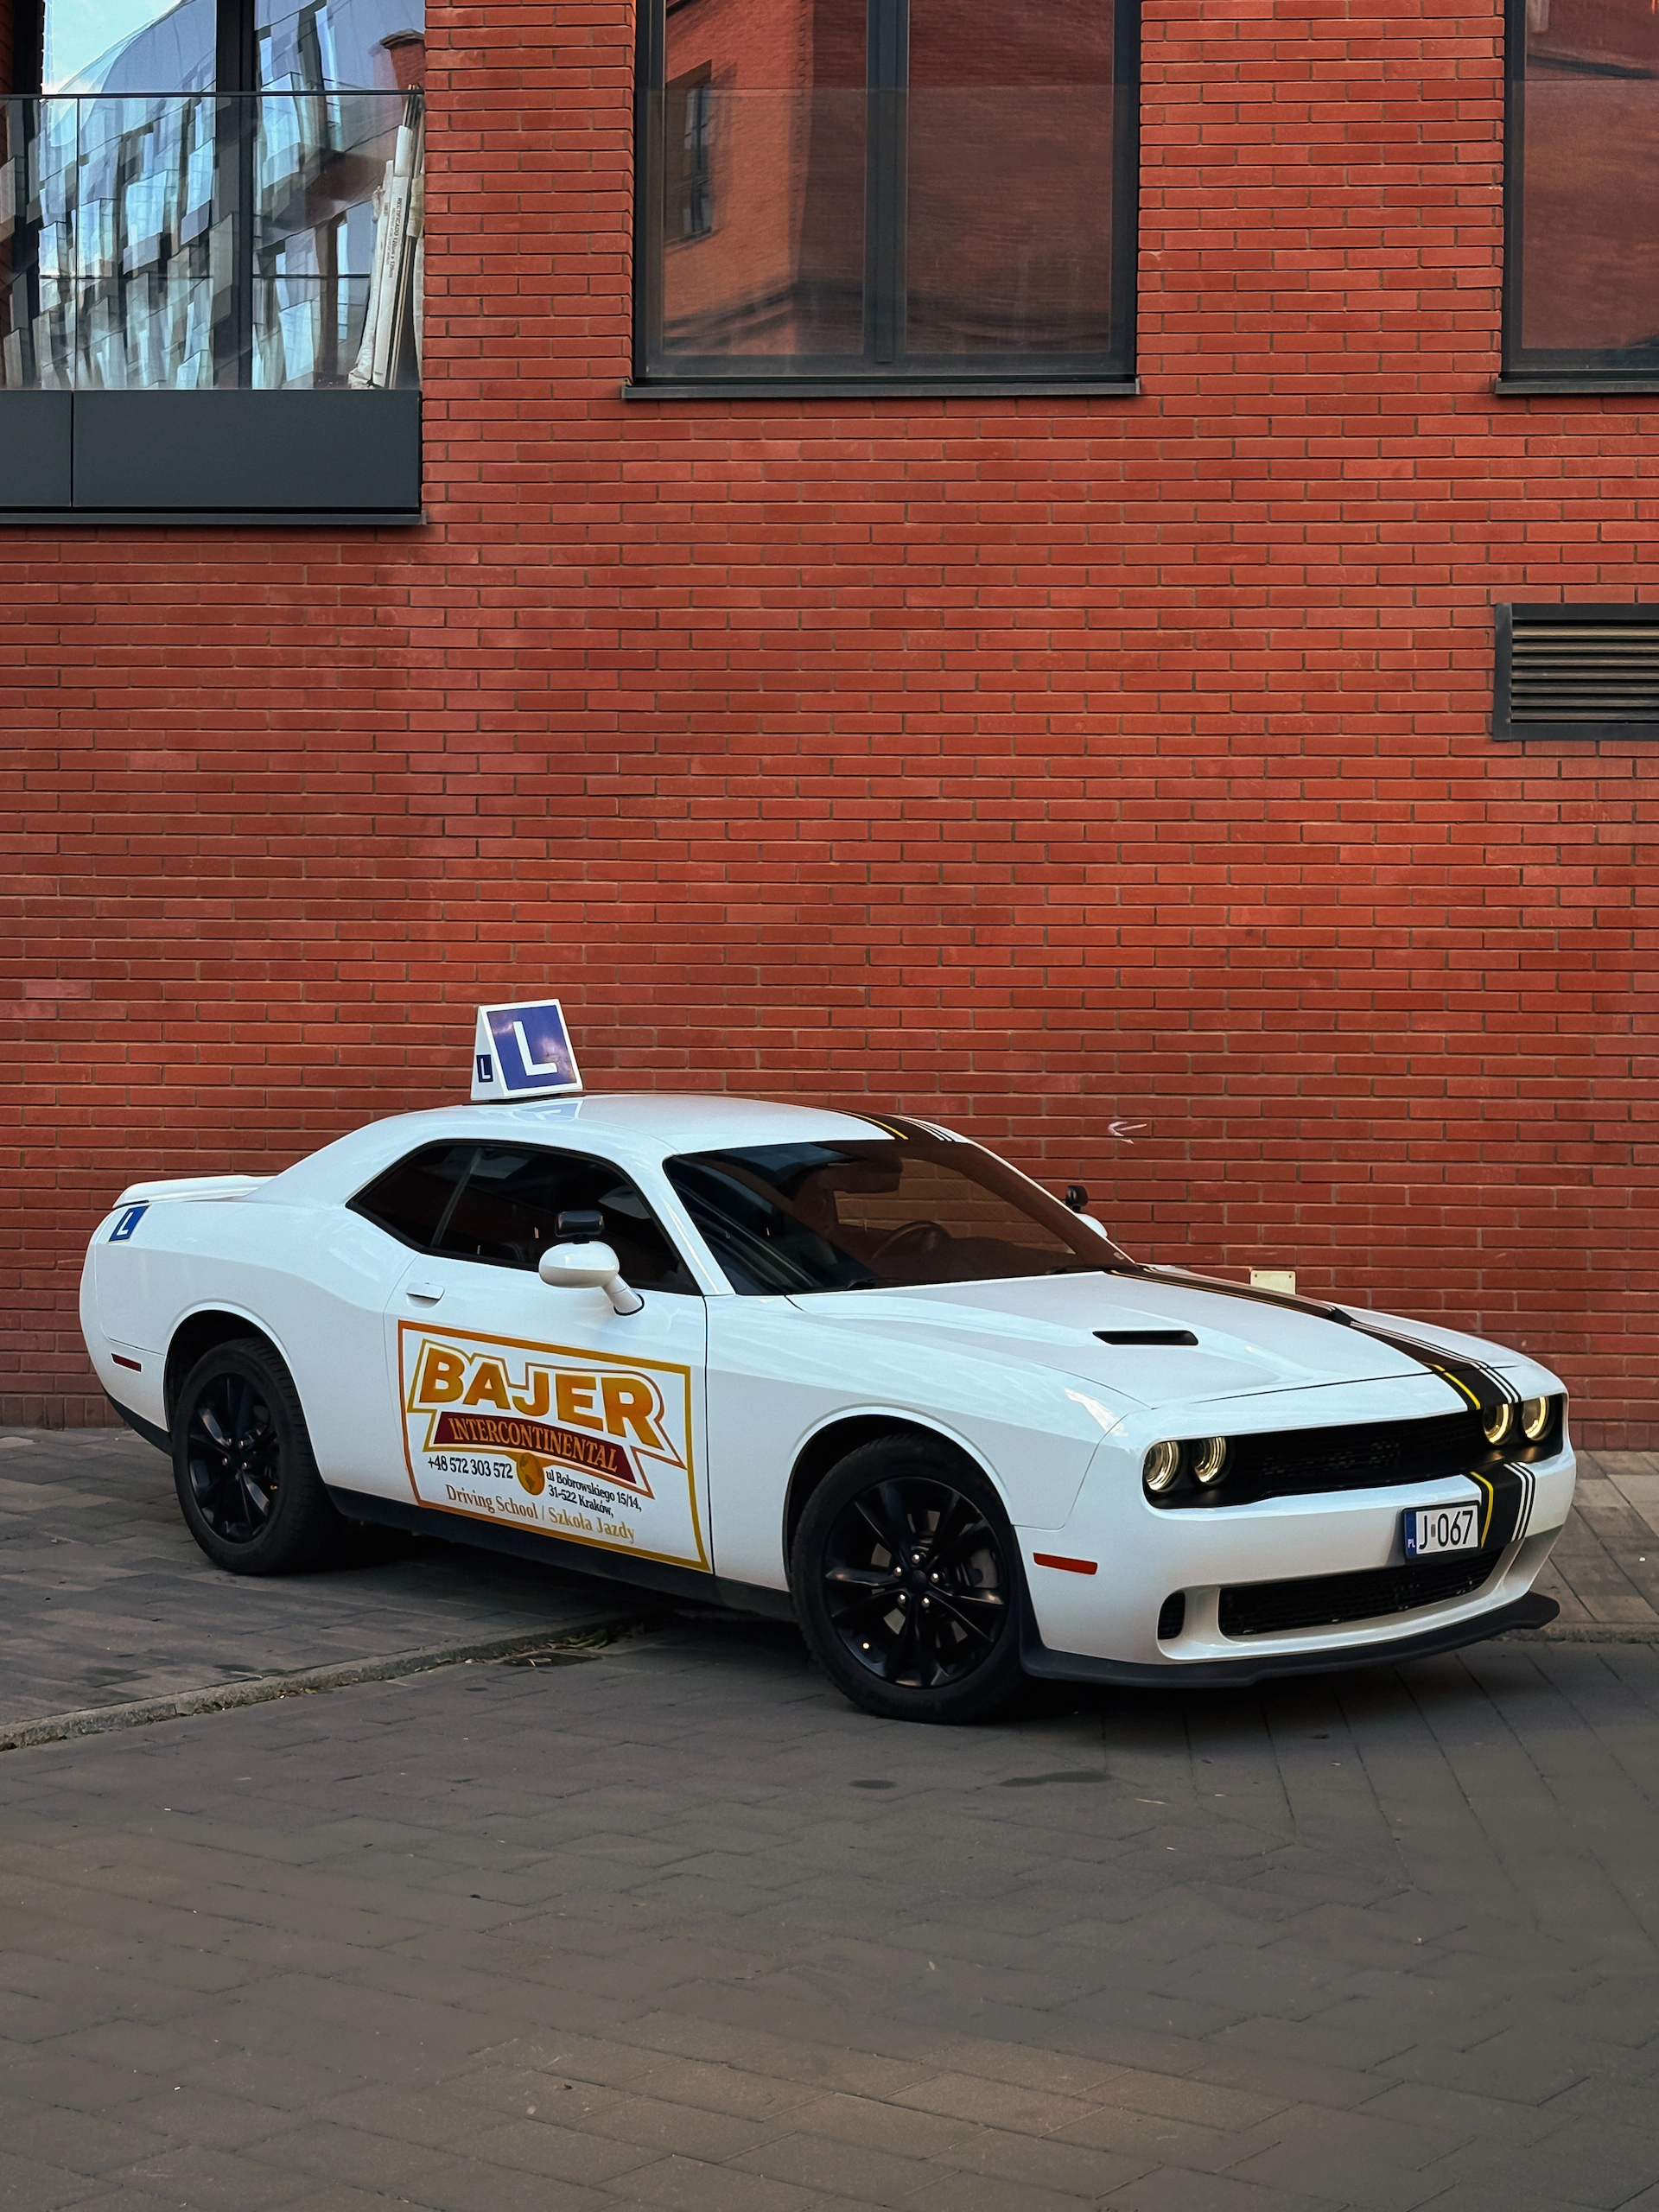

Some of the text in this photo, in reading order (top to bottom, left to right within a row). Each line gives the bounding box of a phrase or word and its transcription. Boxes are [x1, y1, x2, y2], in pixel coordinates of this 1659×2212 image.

[394, 198, 403, 236] RECTIFICADO
[512, 1020, 558, 1077] L
[480, 1058, 491, 1079] L
[116, 1211, 134, 1236] L
[418, 1347, 664, 1451] BAJER
[448, 1418, 617, 1472] INTERCONTINENTAL
[428, 1455, 513, 1479] +48 572 303 572
[546, 1469, 642, 1513] ul Bobrowskiego 15/14,
[548, 1484, 613, 1518] 31-522 Kraków,
[445, 1484, 495, 1514] Driving
[495, 1496, 538, 1520] School
[596, 1516, 635, 1544] Jazdy
[1408, 1538, 1415, 1548] PL
